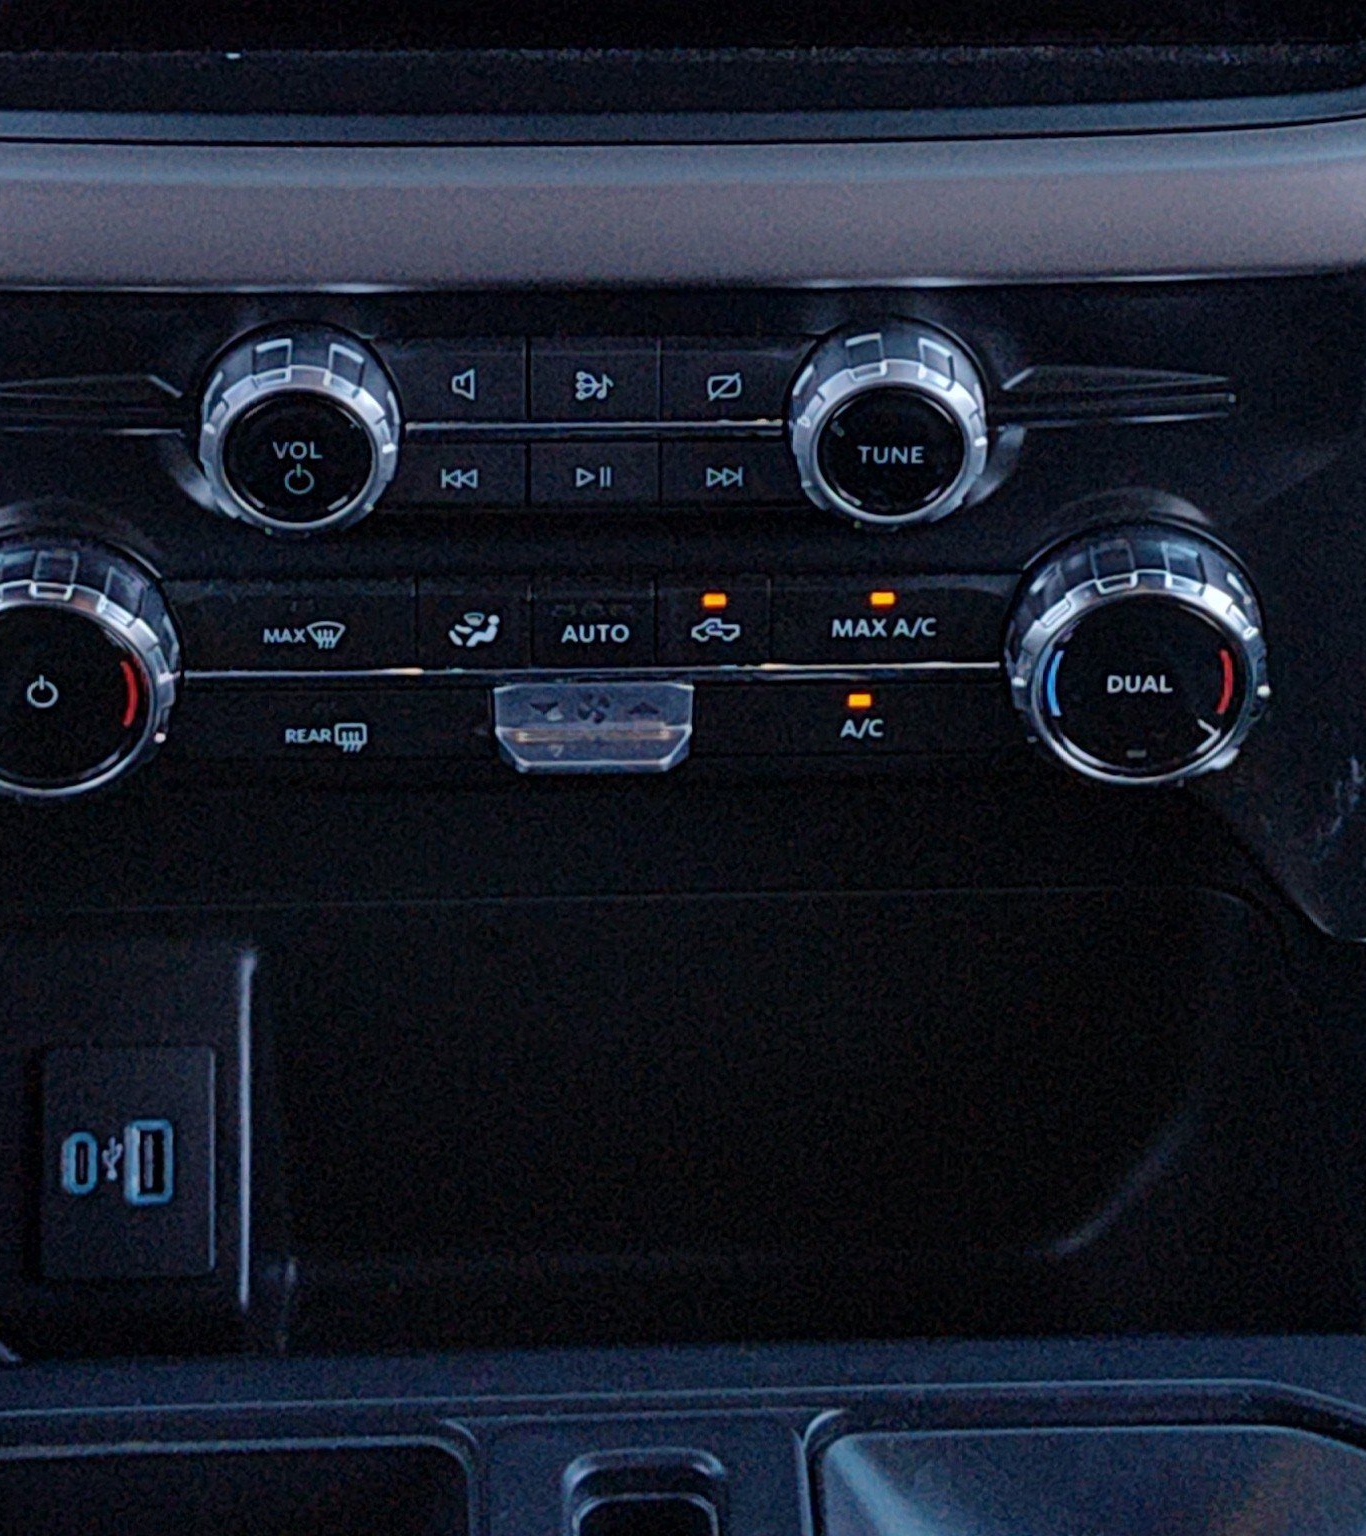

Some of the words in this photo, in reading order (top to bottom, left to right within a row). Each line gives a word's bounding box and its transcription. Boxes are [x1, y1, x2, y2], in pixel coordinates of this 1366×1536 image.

[273, 441, 323, 461] VOL
[858, 445, 925, 465] TUNE
[263, 626, 306, 645] MAX
[561, 624, 631, 645] AUTO
[831, 617, 887, 639] MAX
[893, 616, 937, 639] A/C
[1106, 674, 1173, 694] DUAL
[284, 726, 332, 744] REAR
[840, 718, 884, 739] A/C
